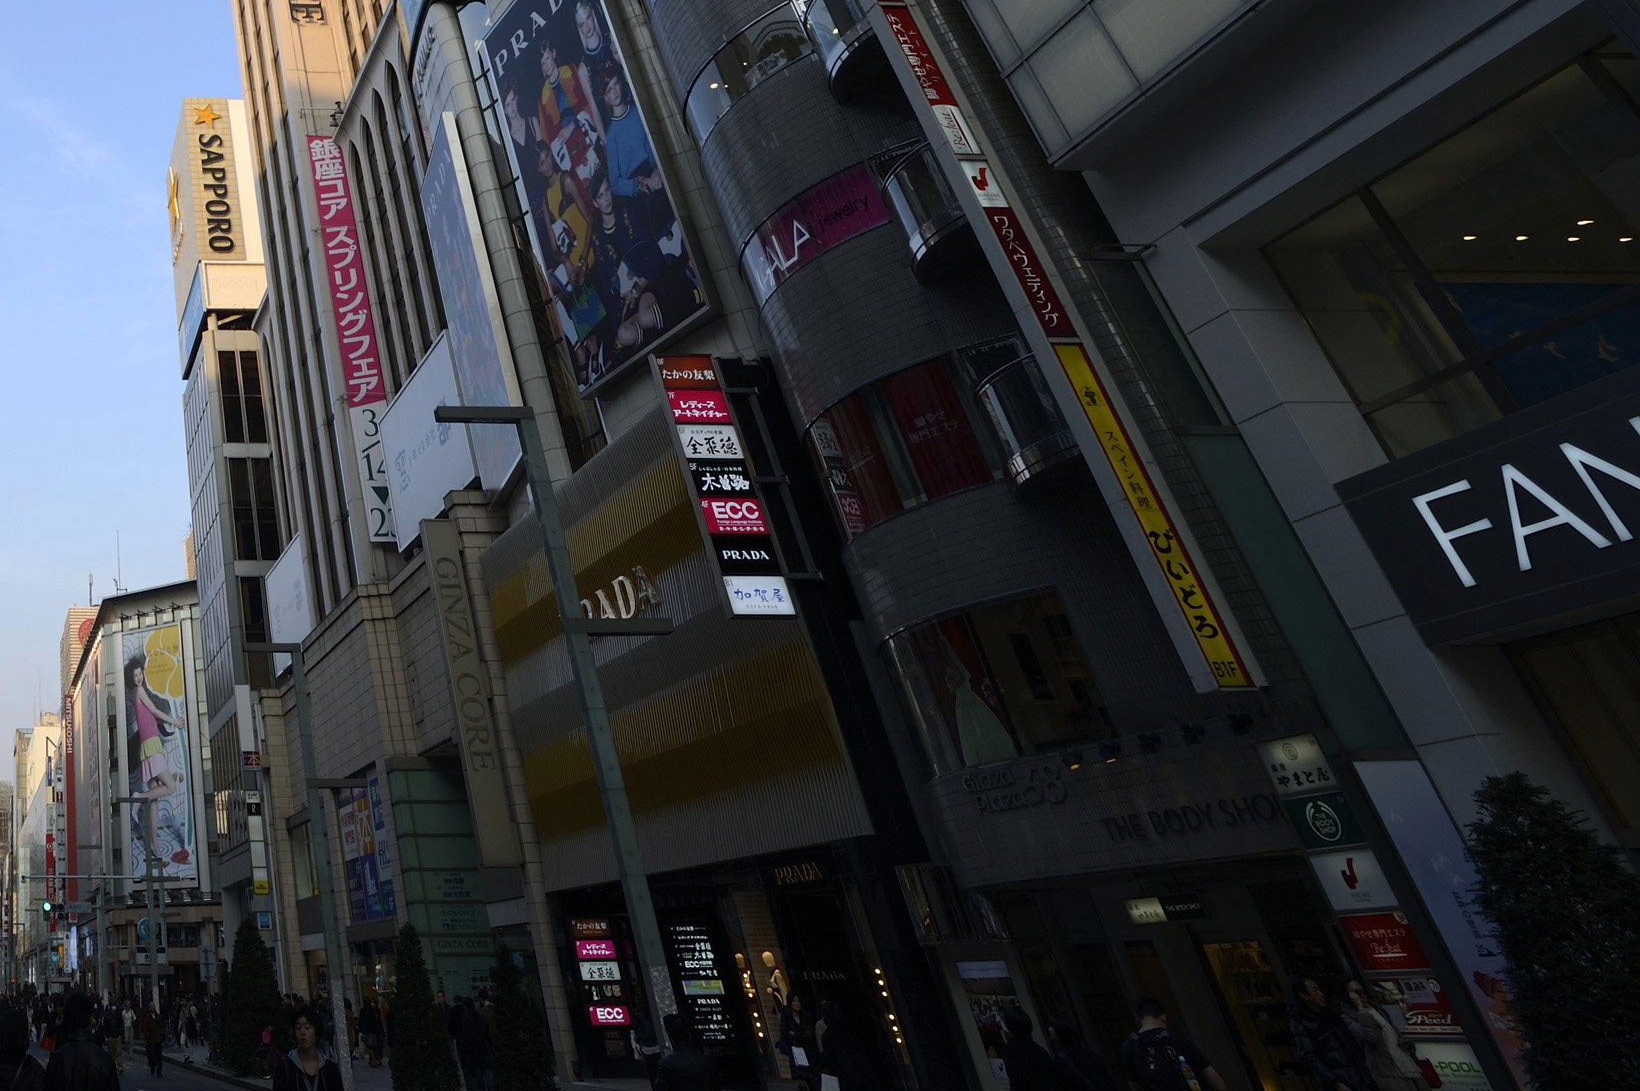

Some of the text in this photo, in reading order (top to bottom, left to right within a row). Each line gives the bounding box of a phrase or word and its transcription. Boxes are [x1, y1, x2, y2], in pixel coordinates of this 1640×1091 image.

[198, 134, 235, 254] SAPPORO
[816, 195, 868, 233] jewelry
[309, 138, 380, 405] 銀座コア スプリングフェア
[1104, 429, 1151, 509] スペイン料理
[711, 501, 759, 519] ECC
[722, 550, 769, 560] PRADA
[1149, 528, 1220, 639] びいどろ
[734, 588, 784, 602] 加賀屋
[435, 557, 495, 773] GINZA CORE
[1213, 660, 1239, 679] B1F
[65, 698, 73, 754] MITSUKOSHI
[1099, 813, 1147, 841] THE
[1147, 802, 1213, 836] BODY
[1316, 818, 1334, 828] BODY
[1319, 825, 1337, 834] SHOP
[774, 861, 824, 885] PRADA
[437, 940, 489, 948] GINZA CORE
[596, 1008, 623, 1019] ECC
[1435, 1061, 1480, 1073] -POOL
